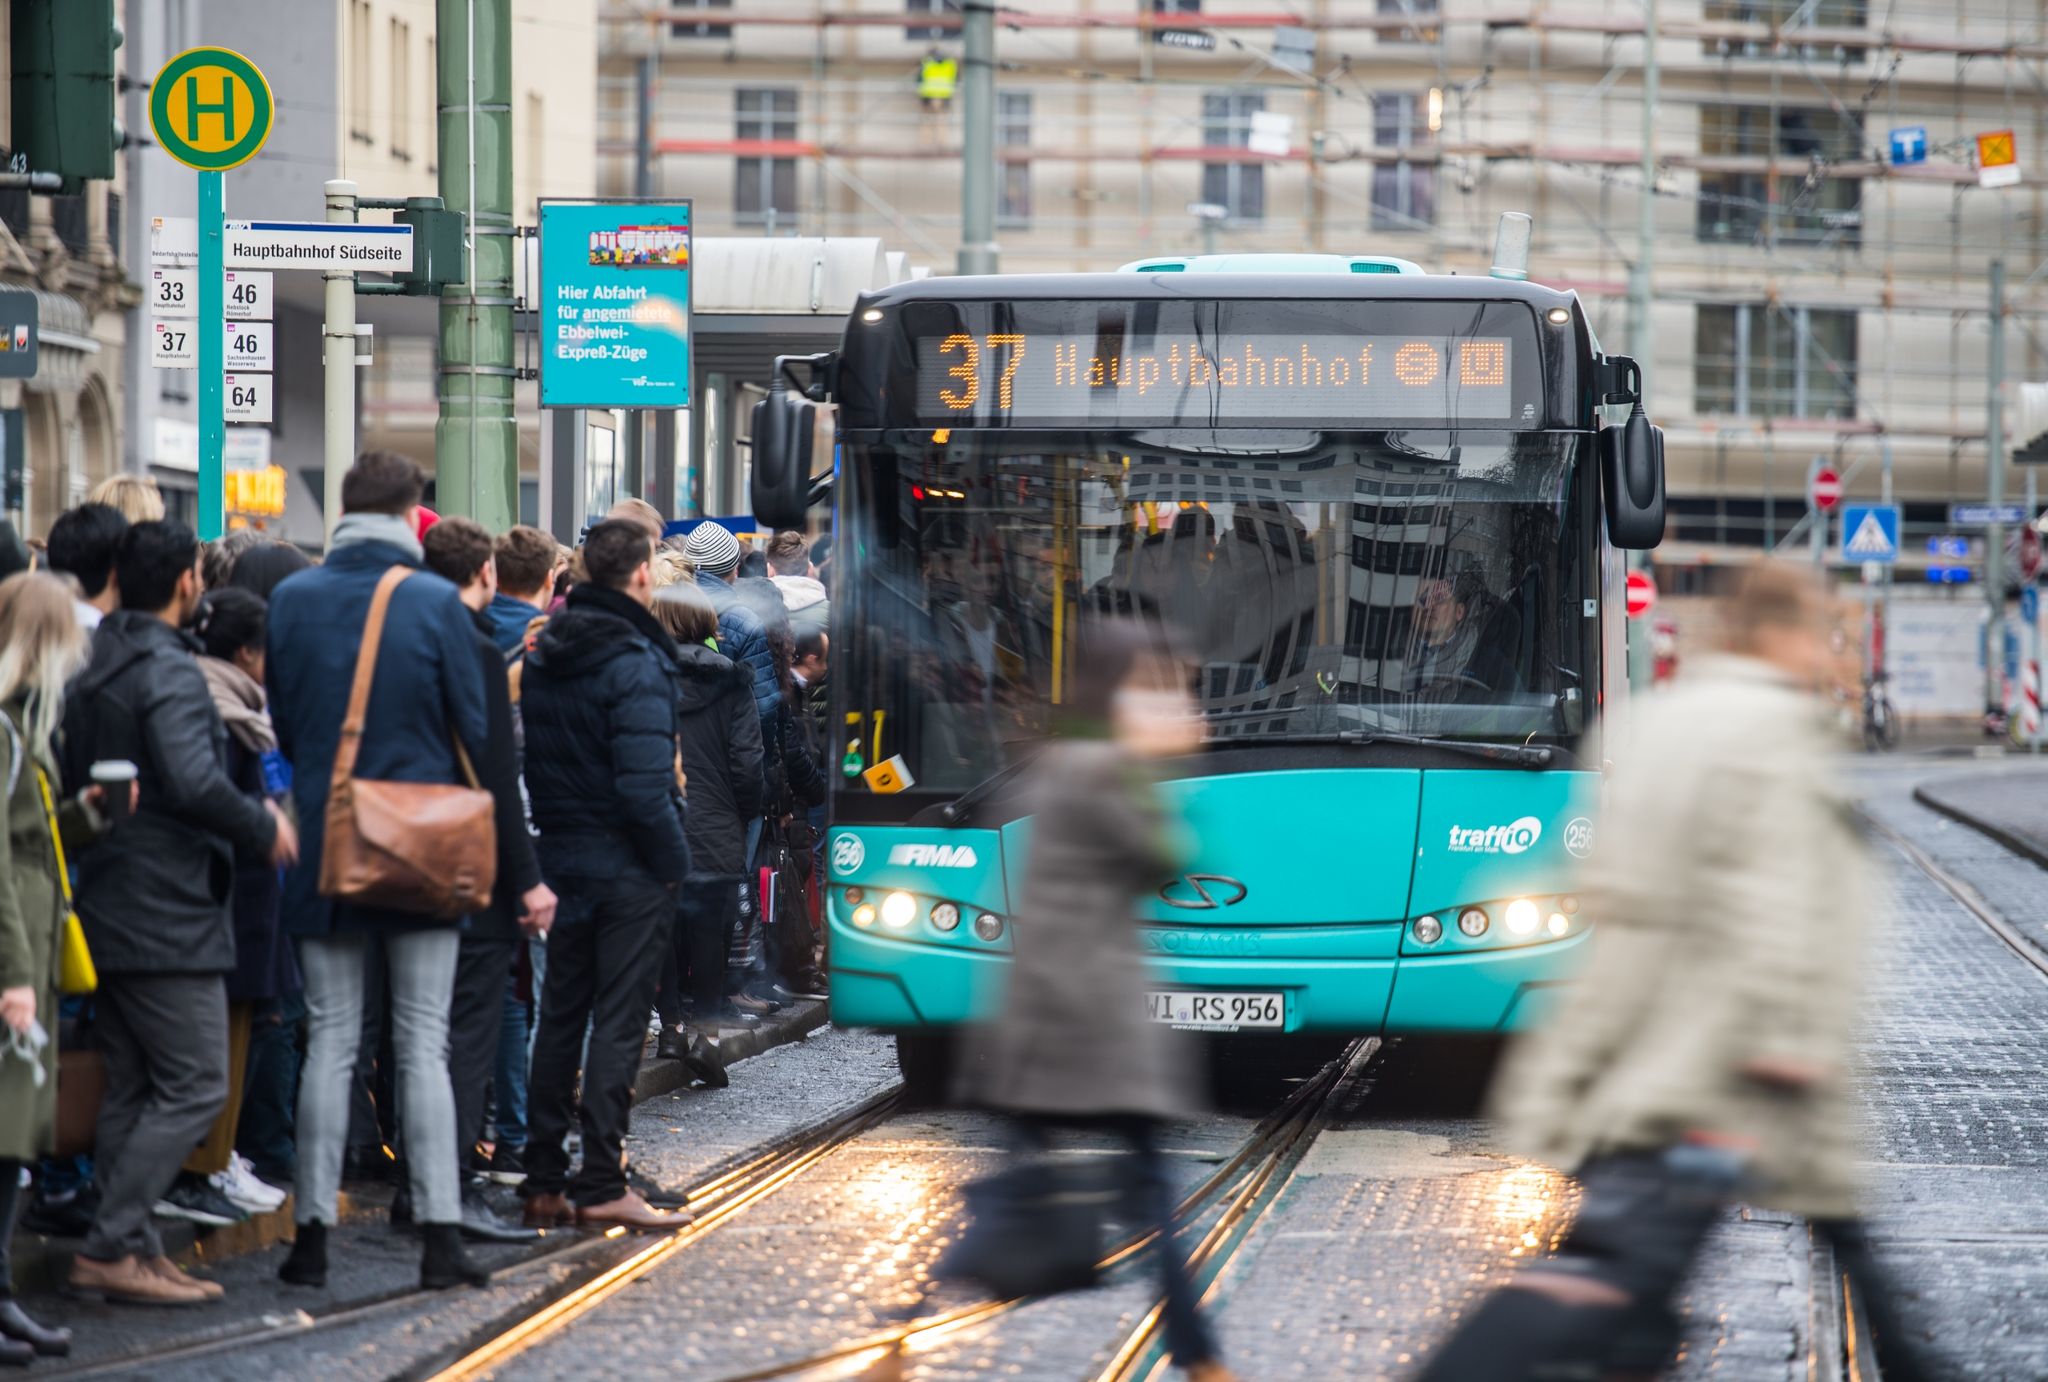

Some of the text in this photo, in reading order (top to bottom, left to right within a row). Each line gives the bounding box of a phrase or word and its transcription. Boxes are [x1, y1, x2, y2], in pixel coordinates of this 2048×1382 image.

[186, 76, 234, 141] H
[10, 152, 27, 174] 43
[233, 242, 402, 261] Hauptbahnhof Südseite
[160, 281, 184, 301] 33
[232, 284, 257, 304] 46
[557, 285, 647, 300] Hier Abfahrt
[557, 305, 672, 322] für angemietete
[162, 332, 186, 351] 37
[557, 325, 629, 339] Ebbelwei-
[234, 334, 258, 353] 46
[557, 344, 648, 361] Expreß-Züge
[939, 334, 1026, 409] 37
[1055, 343, 1374, 395] Hauptbahnhof
[232, 387, 257, 406] 64
[1449, 819, 1540, 852] traffiQ
[1568, 825, 1594, 850] 256
[834, 840, 862, 867] 256
[1193, 996, 1225, 1021] RS
[1231, 997, 1278, 1021] 956
